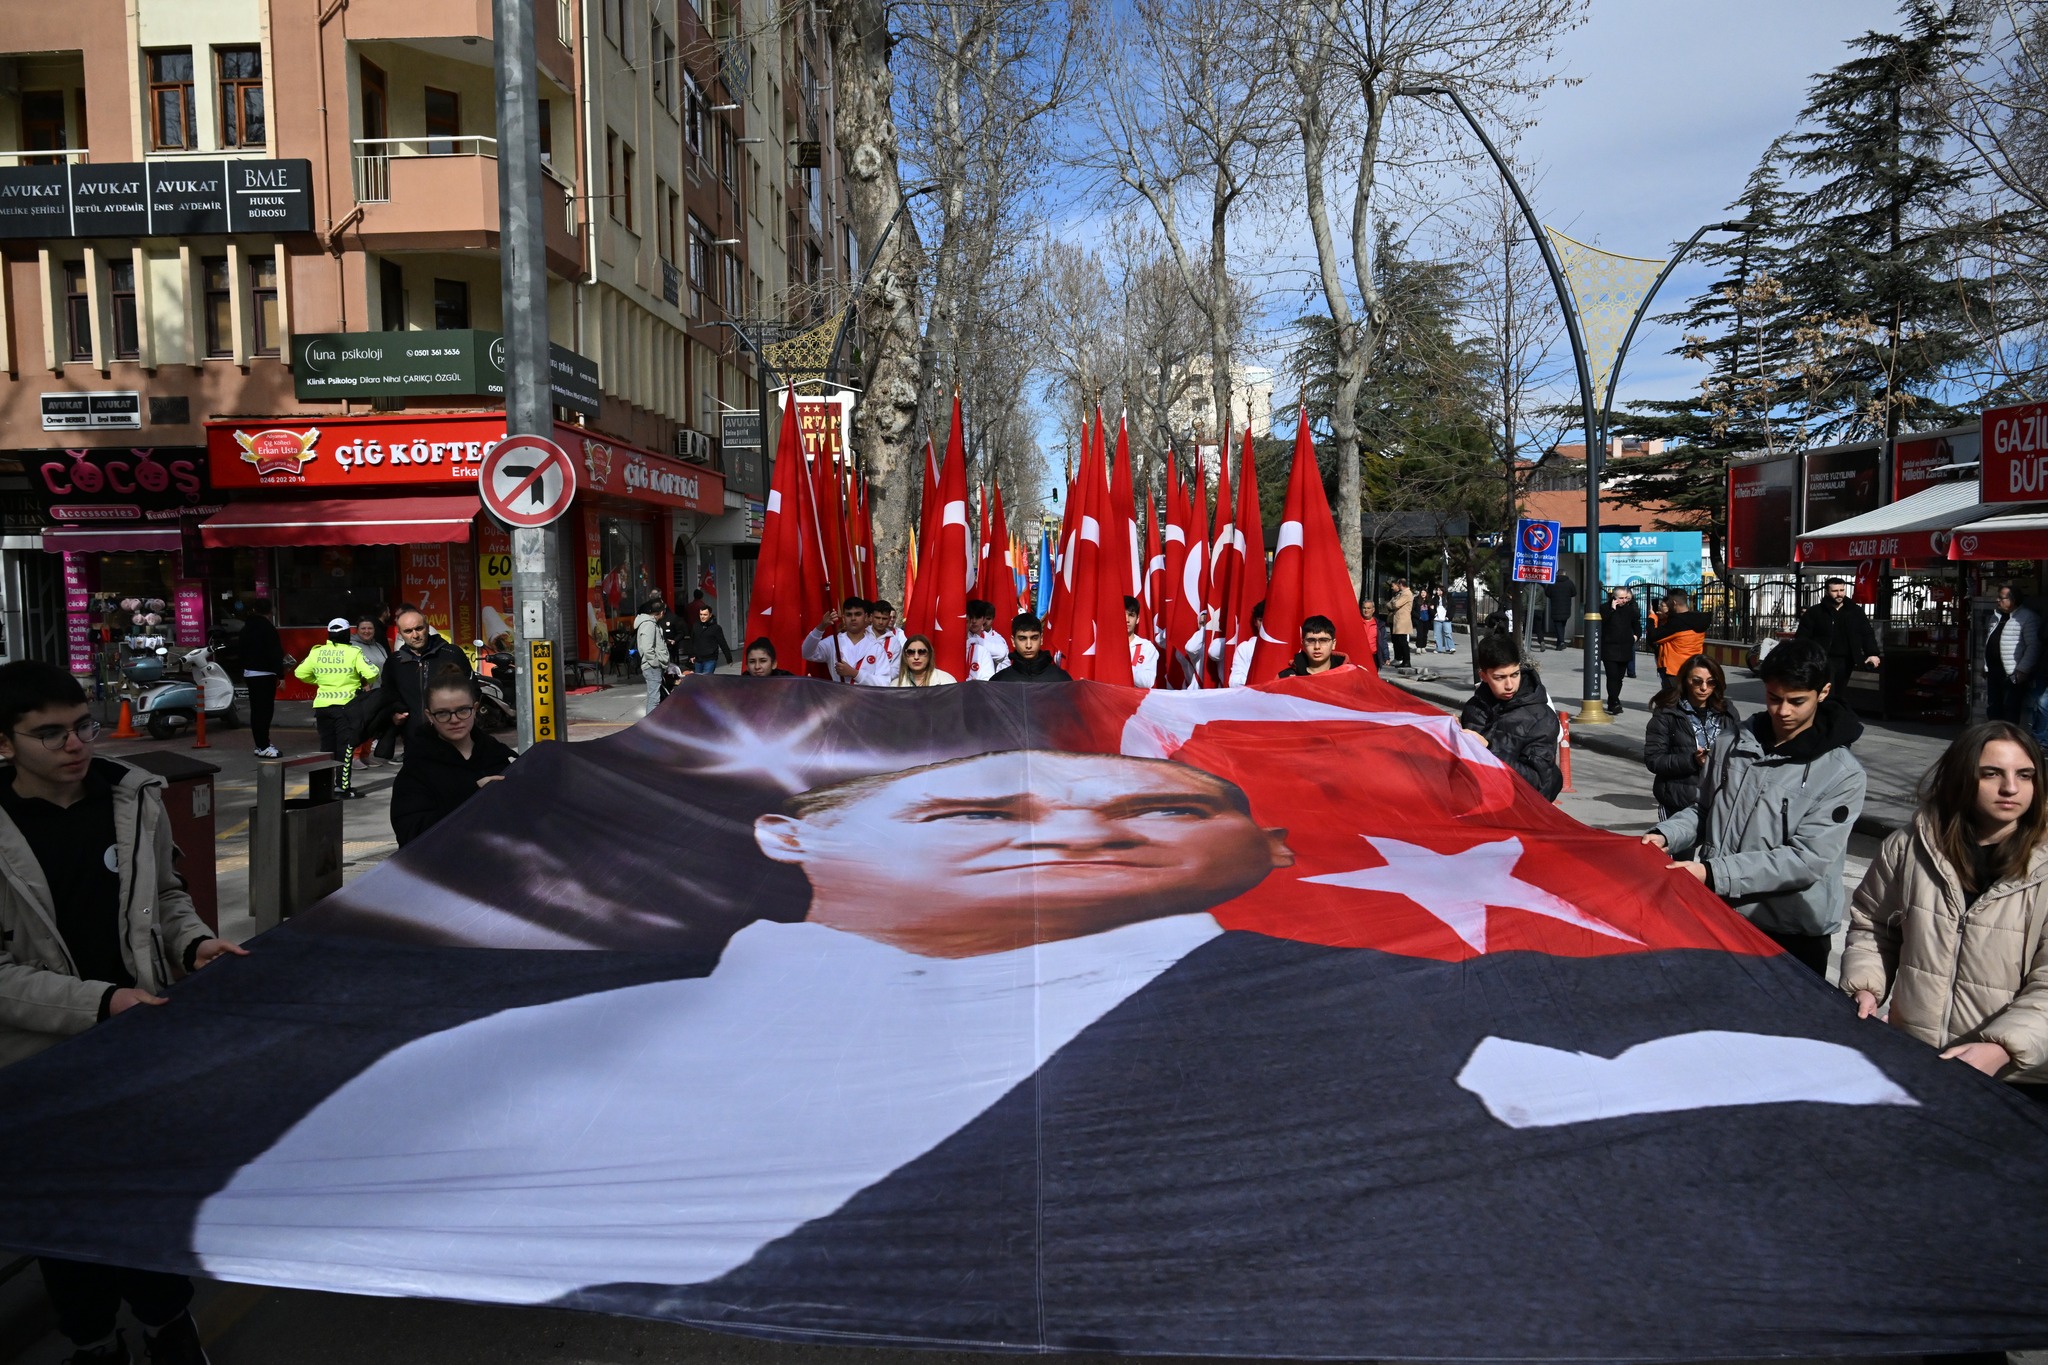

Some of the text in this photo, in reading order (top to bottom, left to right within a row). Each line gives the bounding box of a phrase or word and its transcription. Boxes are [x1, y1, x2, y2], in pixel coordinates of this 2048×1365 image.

[244, 168, 287, 188] BME
[1, 184, 61, 198] AVUKAT
[78, 182, 140, 195] AVUKAT
[156, 180, 218, 193] AVUKAT
[249, 197, 285, 207] HUKUK
[248, 208, 287, 218] BÜROSU
[313, 348, 336, 361] luna
[341, 347, 383, 362] psikoloji
[414, 349, 430, 357] 0501
[431, 348, 442, 357] 361
[307, 373, 462, 387] Klinik Psikolog Dilara Nihal ÇARIKÇI ÖZGÜL
[488, 385, 503, 393] 0501
[48, 401, 83, 410] AVUKAT
[96, 400, 131, 409] AVUKAT
[46, 416, 64, 424] Ömer
[725, 417, 760, 428] AVUKAT
[258, 446, 298, 455] Erkan Usta
[335, 438, 385, 471] ÇİĞ
[452, 466, 481, 478] Erka
[624, 457, 649, 493] ÇİĞ
[650, 467, 699, 500] KÖFTECİ
[58, 509, 134, 518] Accessories
[1634, 536, 1657, 545] TAM
[1849, 538, 1899, 556] GAZİLER BÜFE
[488, 555, 512, 576] 60
[406, 573, 446, 589] Her Ayın
[537, 662, 548, 706] OKUL
